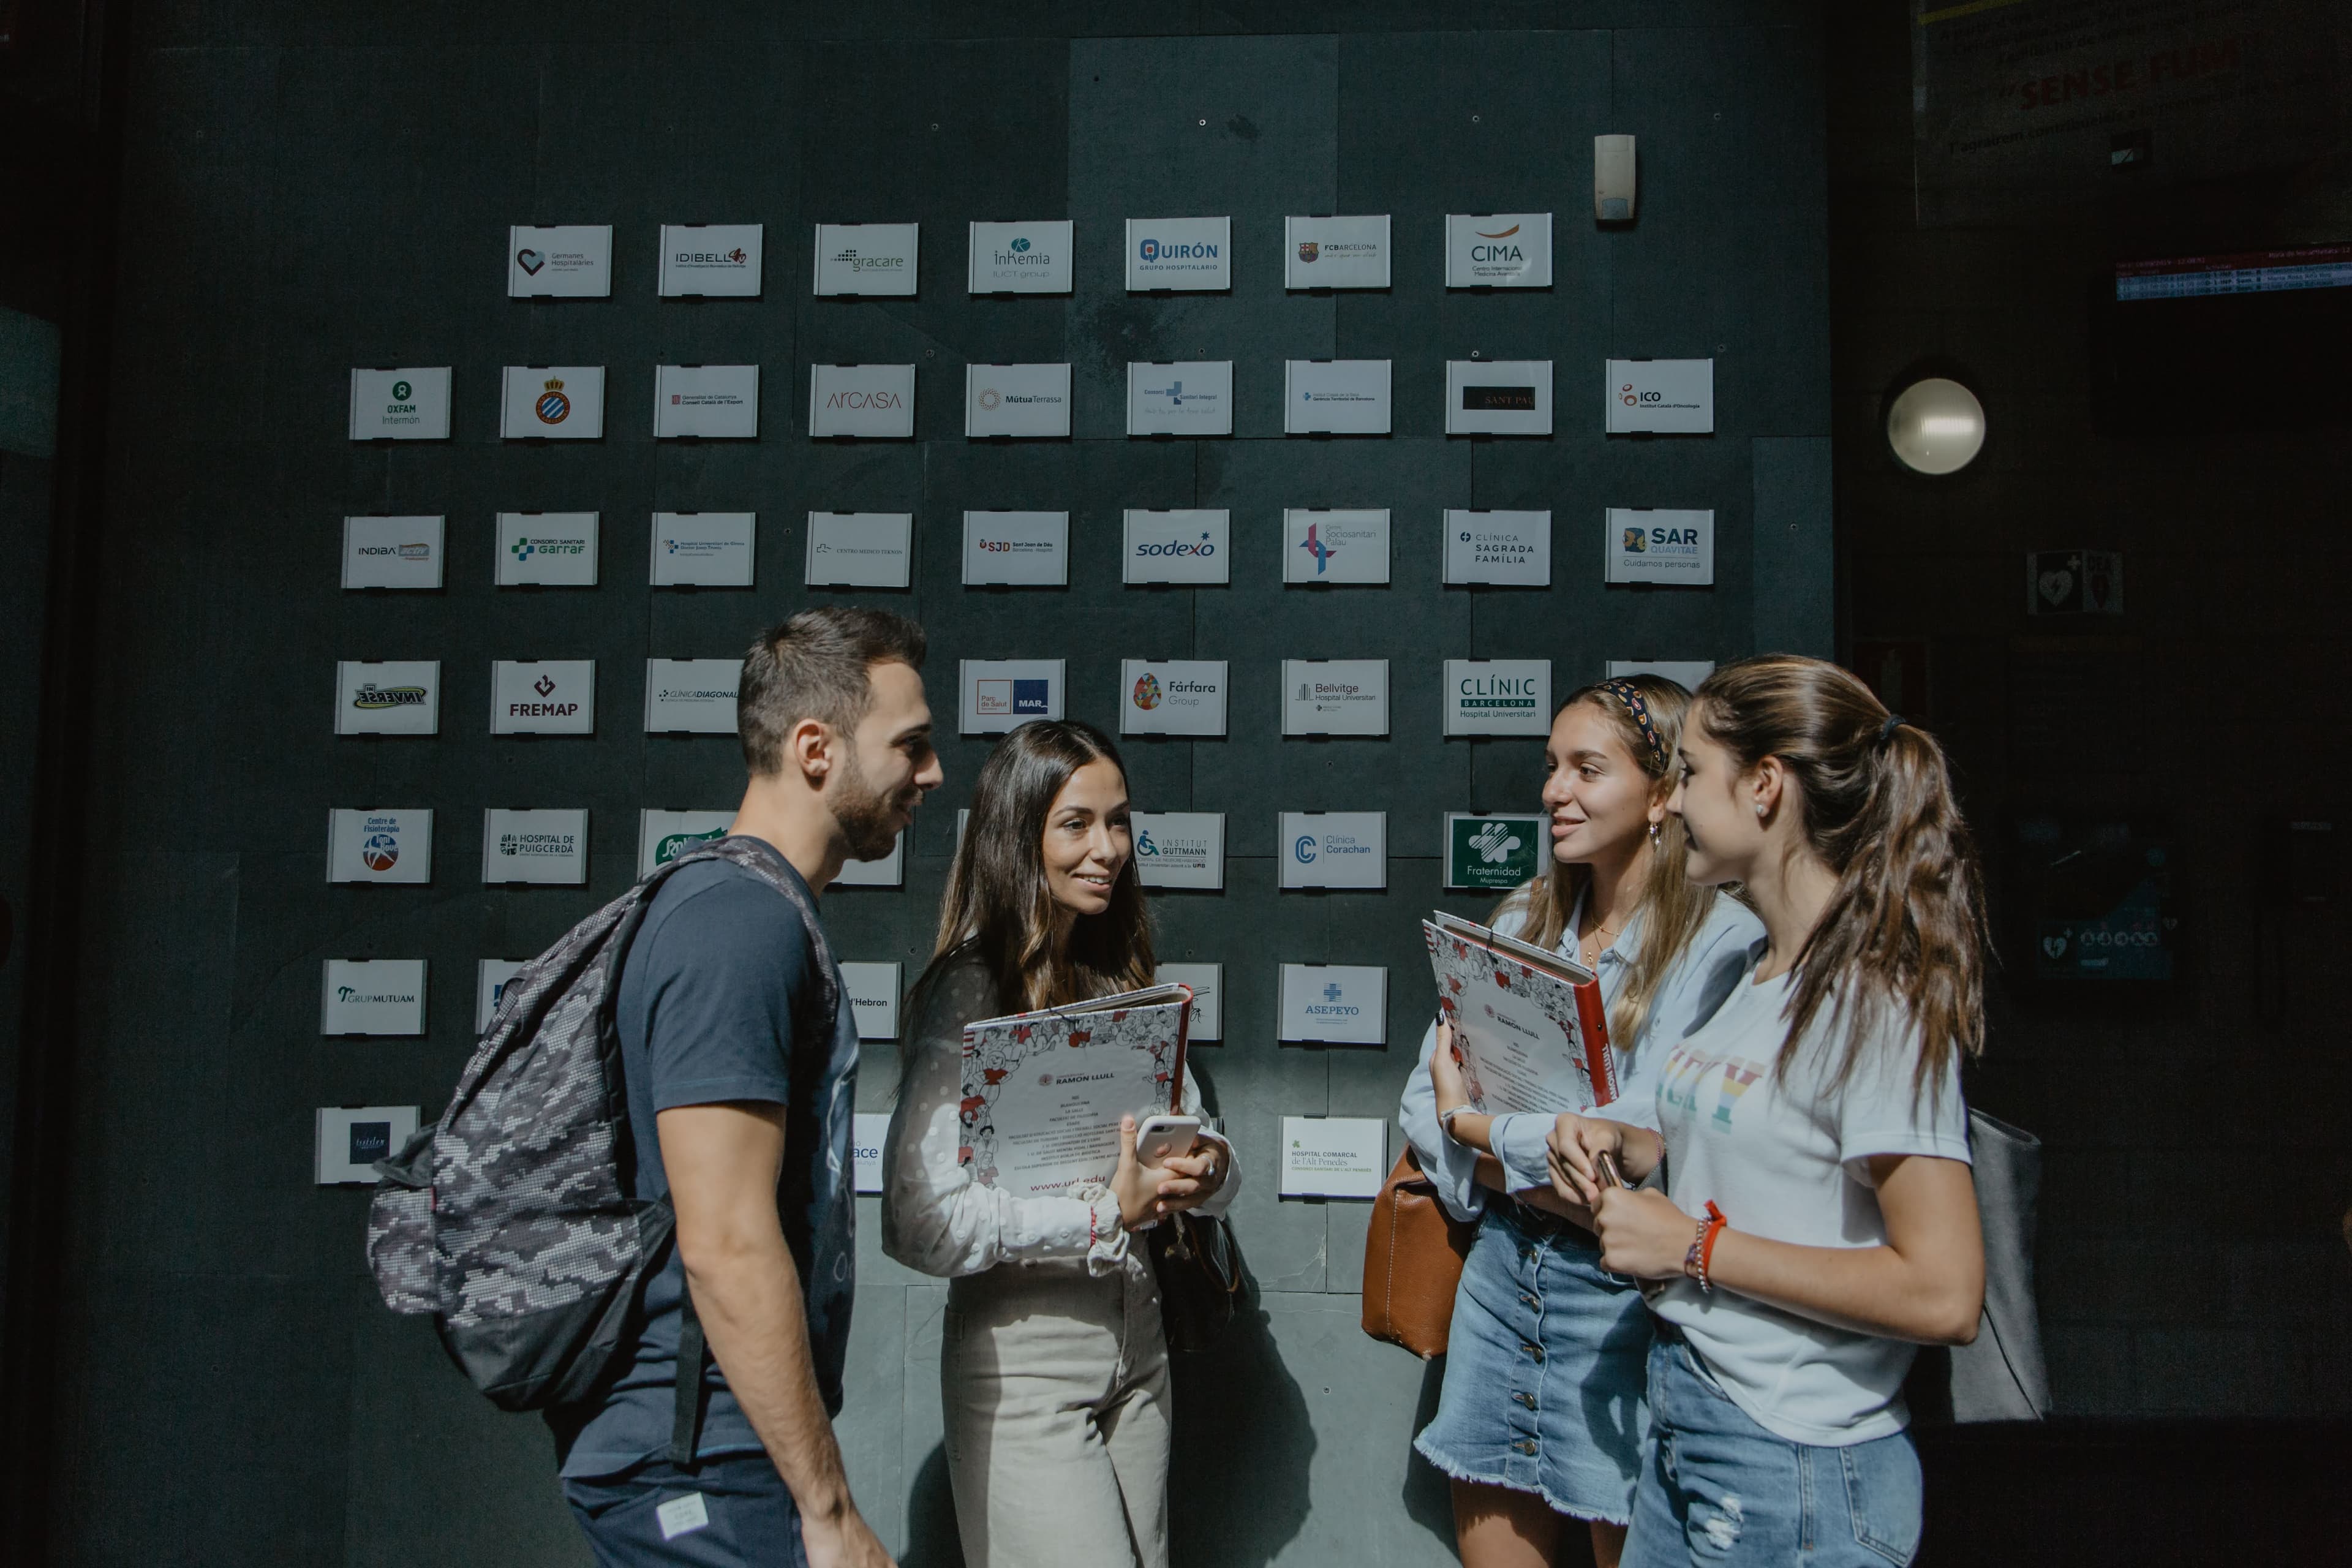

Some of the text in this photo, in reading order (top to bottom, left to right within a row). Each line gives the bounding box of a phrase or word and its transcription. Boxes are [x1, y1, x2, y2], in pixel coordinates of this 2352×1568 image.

[1140, 239, 1218, 263] QUIRÓN
[1471, 246, 1523, 262] CIMA
[676, 254, 731, 262] IDIBELL
[853, 258, 903, 272] gracare
[1640, 392, 1661, 402] ICO
[388, 405, 417, 413] OXFAM
[383, 416, 421, 424] Intermón
[1325, 529, 1376, 538] Sociosanitari
[1476, 532, 1518, 541] CLÍNICA
[1651, 528, 1698, 545] SAR
[988, 542, 1010, 552] SJD
[1136, 540, 1215, 556] sodexo
[1476, 545, 1534, 553] SAGRADA
[1651, 546, 1698, 554] QUAVITAE
[1476, 554, 1526, 564] FAMÍLIA
[1624, 559, 1662, 568] Cuidamos
[1169, 680, 1216, 693] Fárfara
[1316, 683, 1359, 695] Bellvitge
[1460, 674, 1536, 695] CLÍNIC
[1169, 695, 1199, 707] Group
[510, 703, 578, 717] FREMAP
[1460, 710, 1490, 719] Hospital
[364, 825, 399, 834] Fisioteràpia
[520, 834, 560, 843] HOSPITAL
[1326, 835, 1355, 844] Clínica
[519, 843, 573, 853] PUIGCERDÀ
[1163, 839, 1207, 848] INSTITUT
[1326, 845, 1371, 854] Corachan
[1467, 865, 1521, 876] Fraternidad
[348, 994, 415, 1003] GRUPMUTUAM
[1305, 1005, 1359, 1016] ASEPEYO
[1497, 1016, 1521, 1031] RAMON
[1521, 1027, 1540, 1040] LLULL
[1056, 1076, 1089, 1085] RAMON
[1319, 1158, 1348, 1166] Penedès
